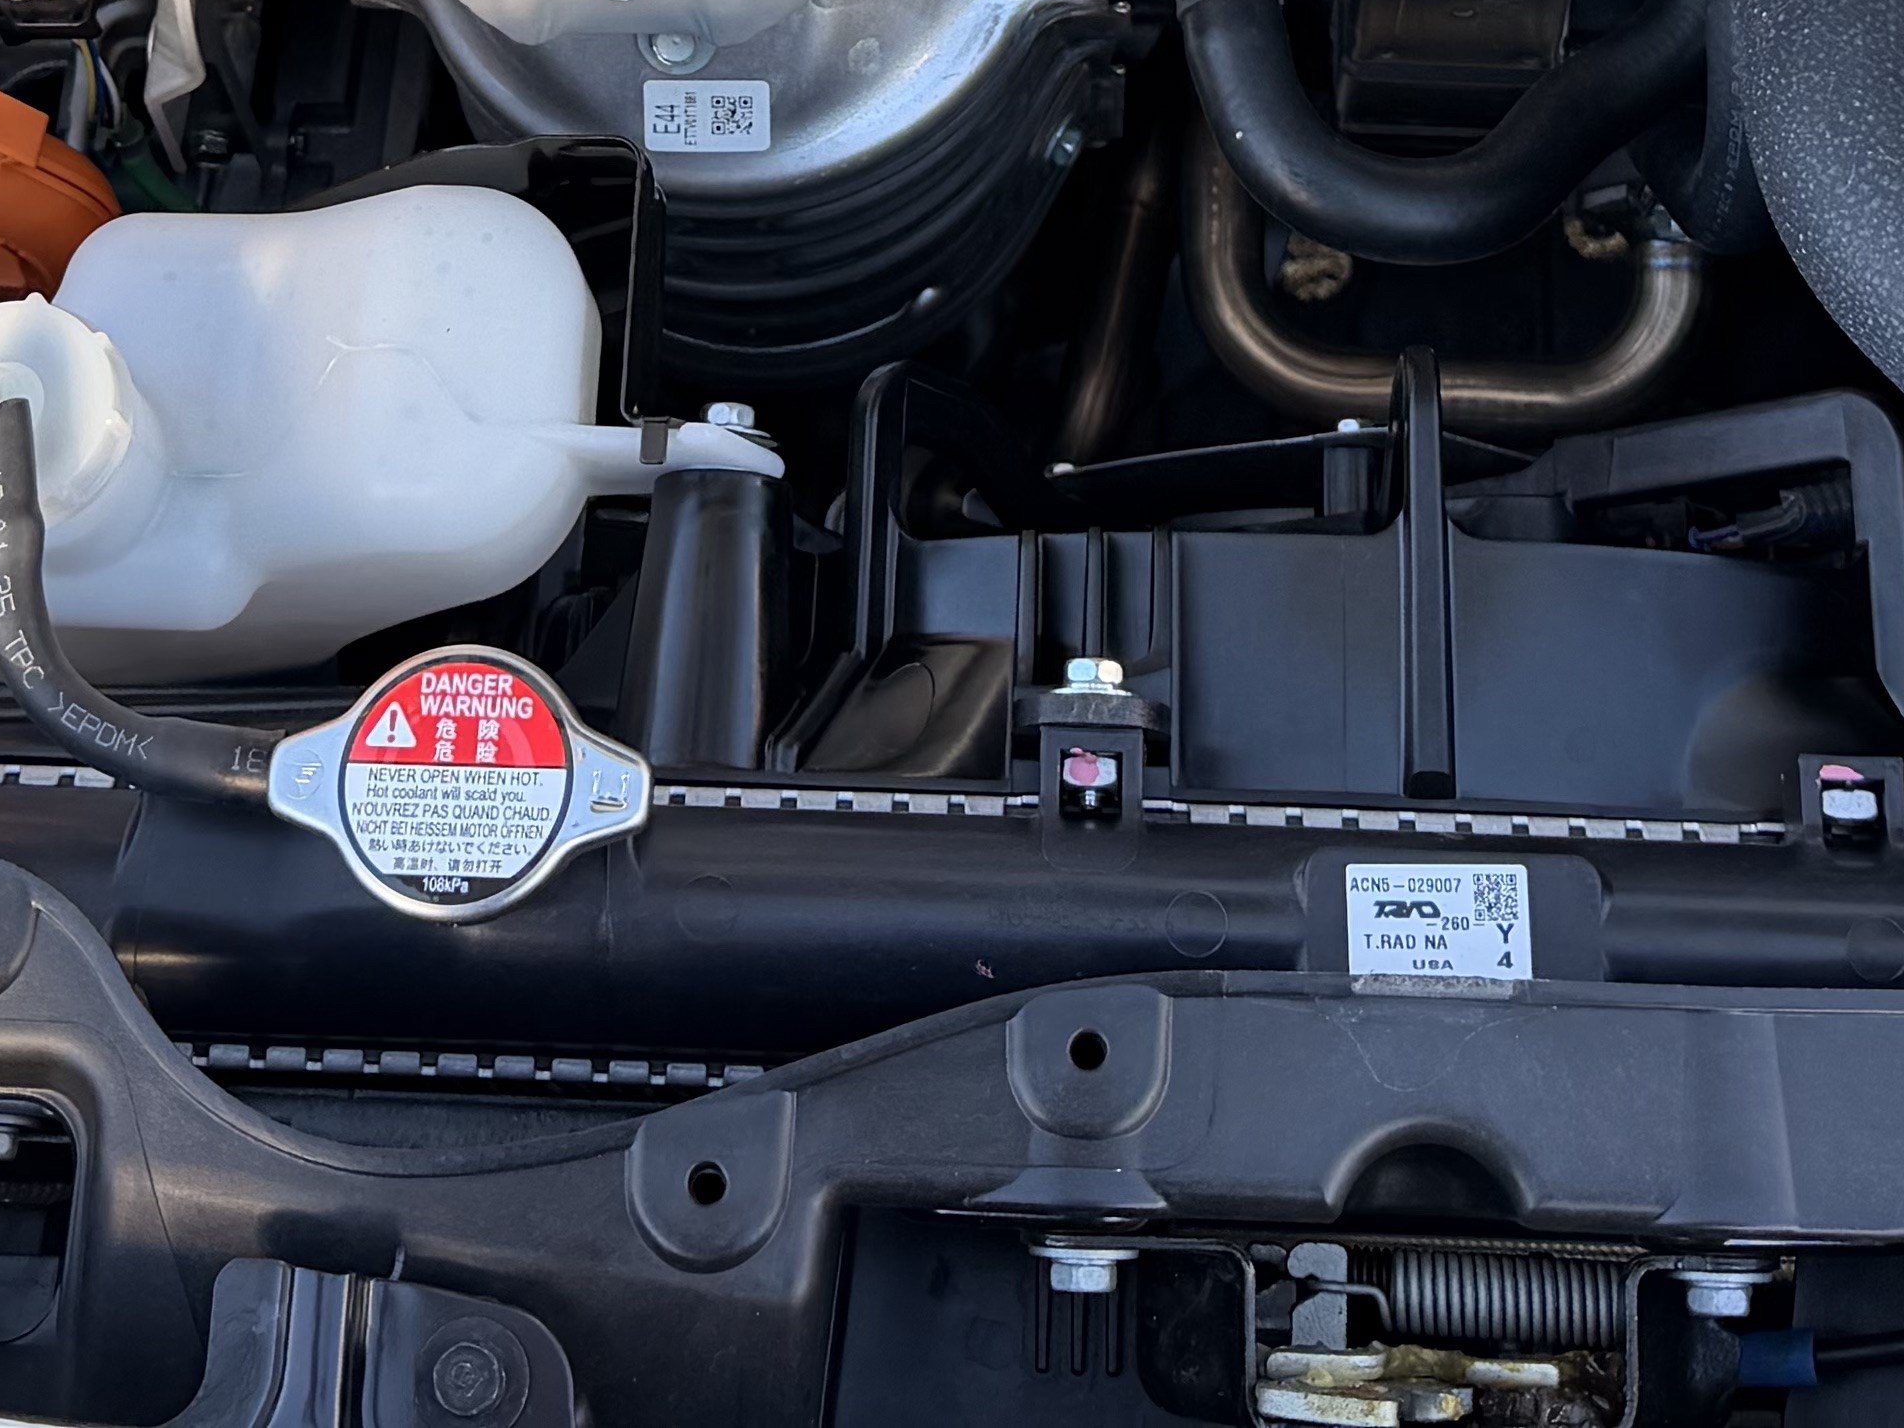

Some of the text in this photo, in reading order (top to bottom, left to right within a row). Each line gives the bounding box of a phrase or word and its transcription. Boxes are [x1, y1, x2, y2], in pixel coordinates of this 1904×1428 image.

[653, 104, 681, 134] E44
[4, 629, 45, 690] TPC
[421, 672, 513, 694] DANGER
[420, 696, 534, 719] WARNUNG
[368, 767, 416, 783] NEVER
[420, 769, 459, 784] OPEN
[463, 770, 507, 786] WHEN
[367, 784, 390, 799] Hot
[392, 785, 439, 800] coolant
[442, 786, 461, 801] will
[352, 802, 419, 818] N'OUVREZ
[422, 804, 449, 819] PAS
[452, 805, 500, 821] QUAND
[459, 823, 499, 839] MOTOR
[1496, 923, 1514, 944] Y
[1363, 933, 1514, 968] T.RAD NA 4
[1412, 959, 1454, 970] USA
